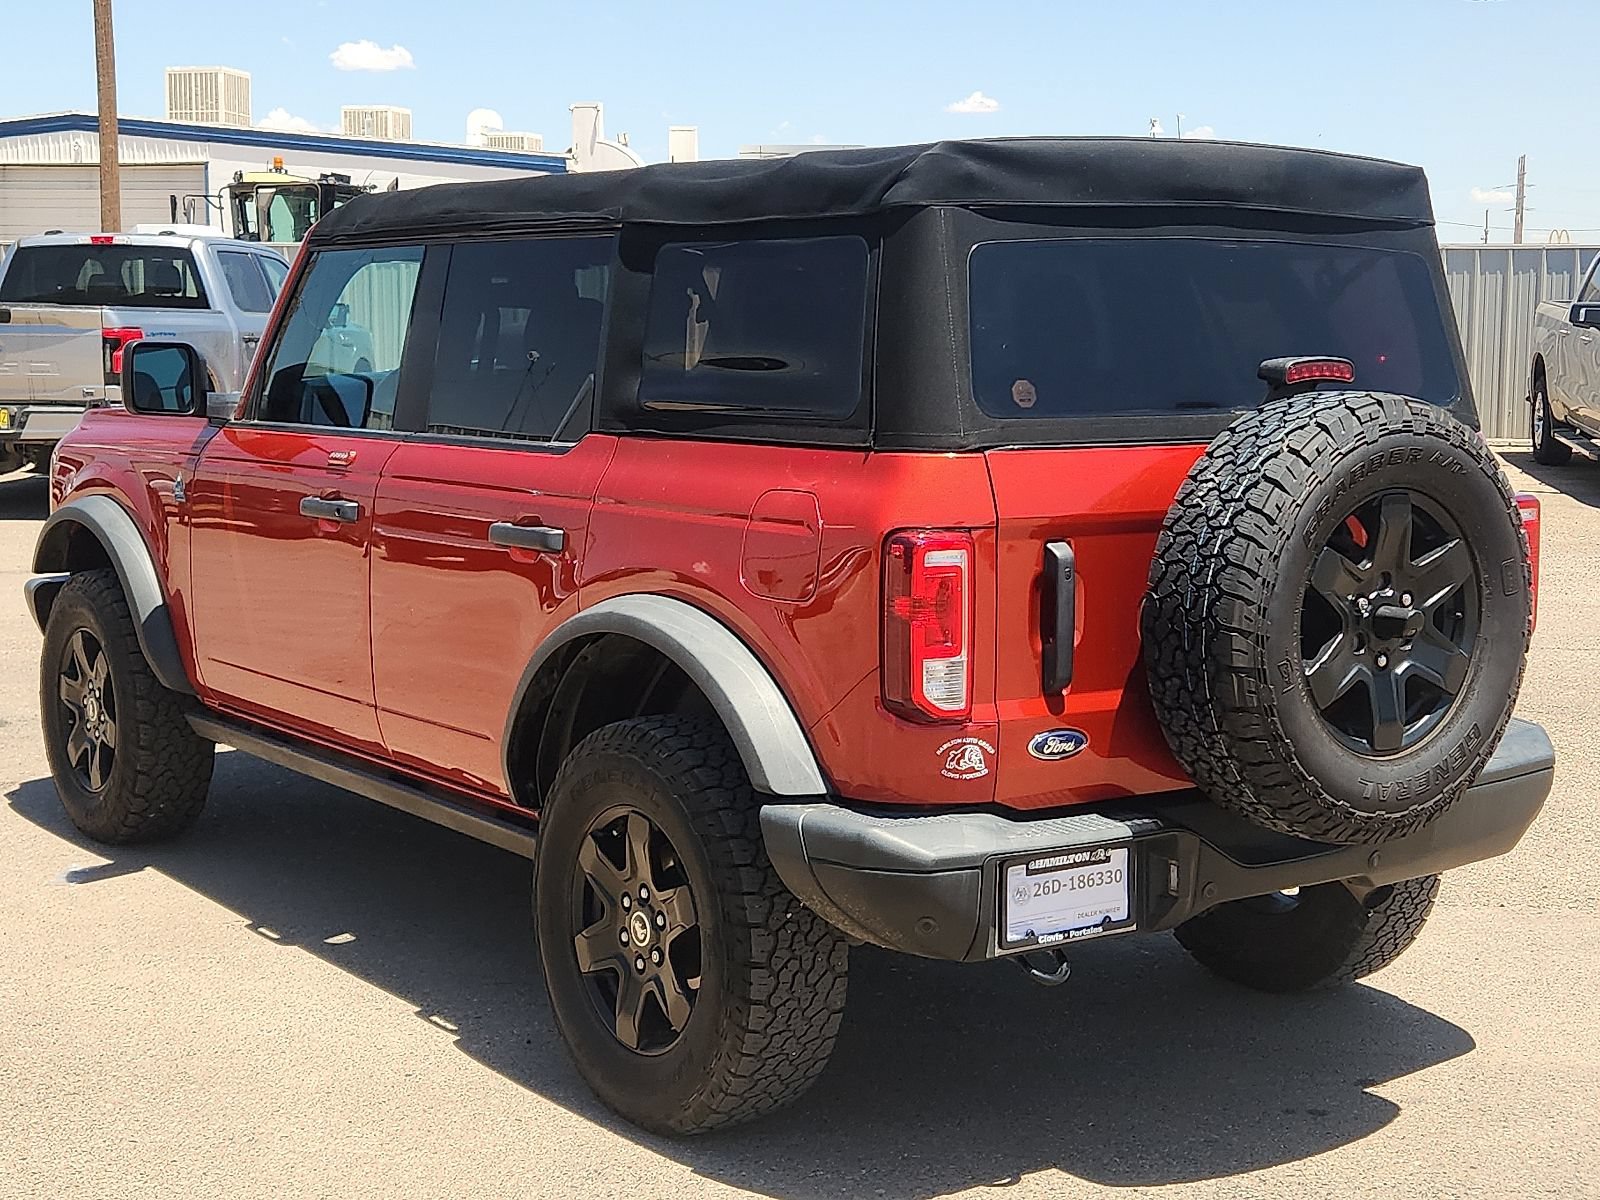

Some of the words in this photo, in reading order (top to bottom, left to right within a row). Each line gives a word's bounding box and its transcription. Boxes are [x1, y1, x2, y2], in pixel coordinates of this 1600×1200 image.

[1303, 447, 1423, 548] GRABBER
[1043, 736, 1075, 754] Ford
[1358, 722, 1482, 801] GENERAL
[1033, 869, 1123, 898] 26D-186330
[1038, 932, 1064, 944] Clovis
